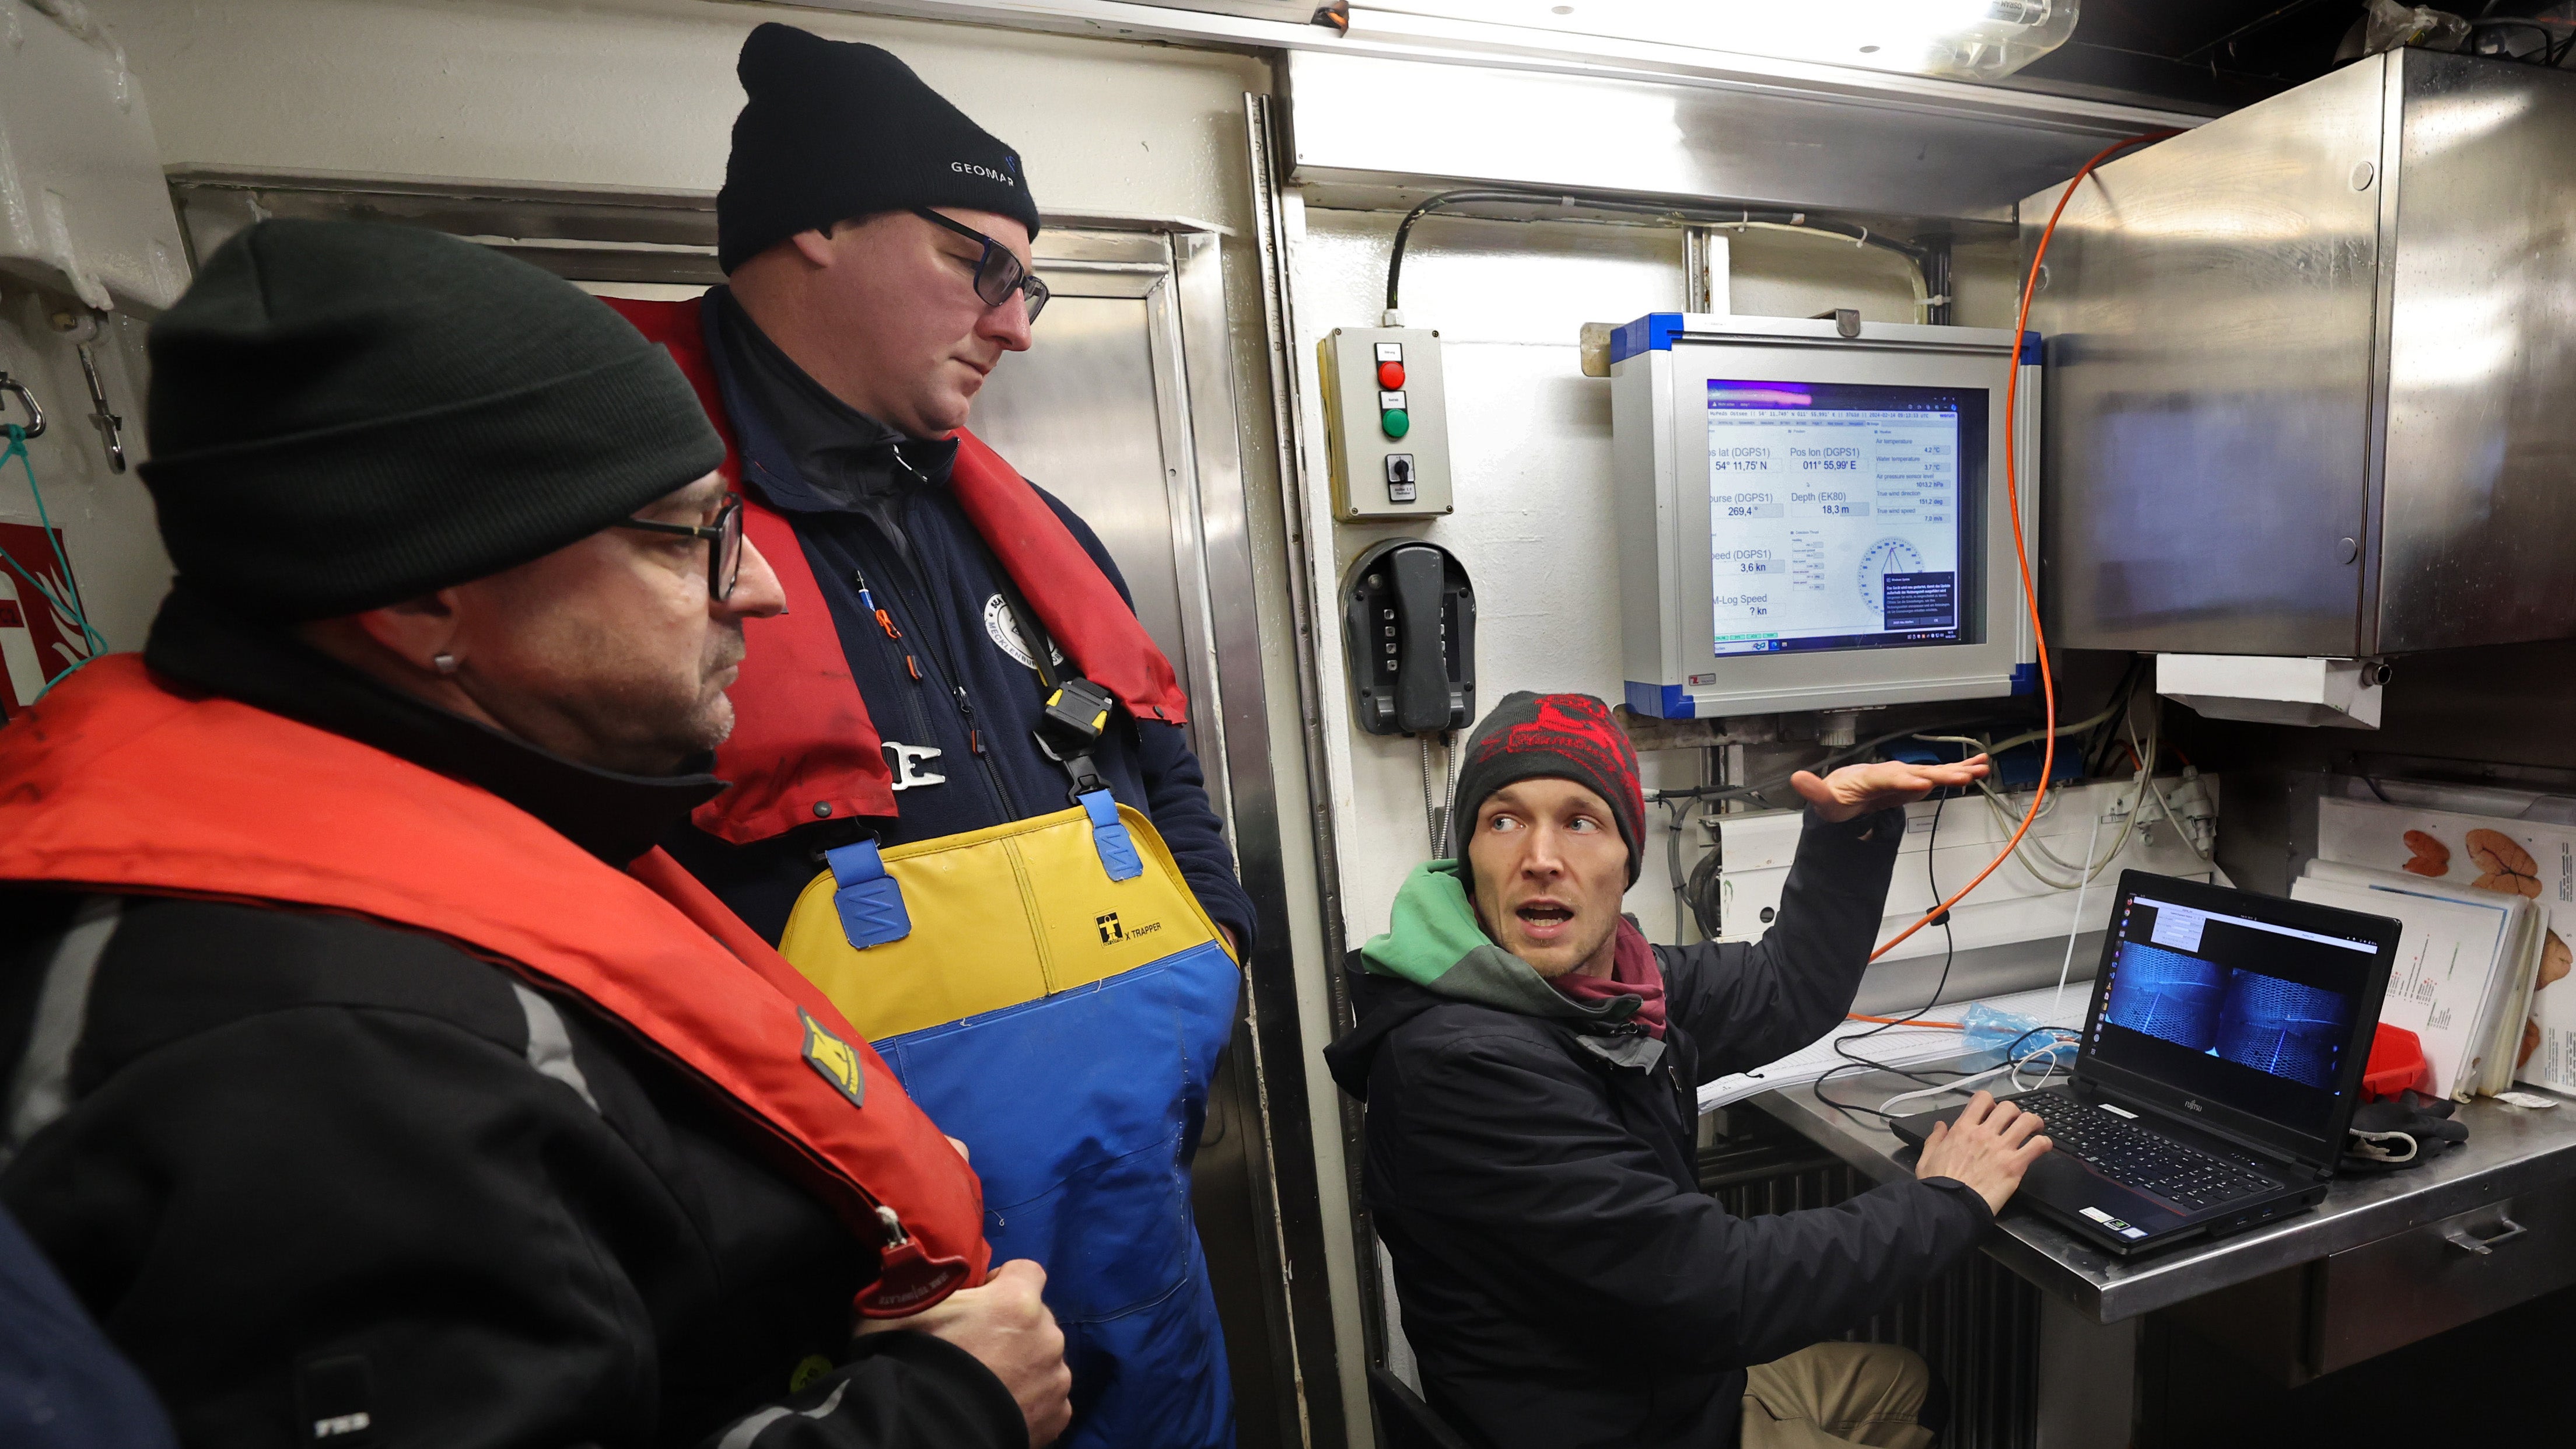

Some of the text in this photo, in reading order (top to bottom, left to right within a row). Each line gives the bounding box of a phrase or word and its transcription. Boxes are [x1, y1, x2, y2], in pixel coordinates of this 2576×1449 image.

[2001, 1, 2022, 9] OSRAM
[951, 160, 1014, 187] GEOMAR
[1718, 448, 1729, 457] lat
[1732, 447, 1770, 459] (DGPS1)
[1790, 447, 1860, 458] Pos lon (DGPS1)
[1716, 461, 1730, 470] 54°
[1760, 461, 1767, 470] N
[1850, 461, 1856, 470] E
[1735, 493, 1773, 504] (DGPS1)
[1791, 492, 1846, 503] Depth (EK80)
[1728, 506, 1752, 516] 269,4
[1822, 505, 1839, 514] 18,3
[1733, 550, 1772, 562] (DGPS1)
[1740, 562, 1766, 573] 3,6 kn
[1741, 594, 1768, 605] Speed
[1757, 607, 1767, 615] kn
[988, 621, 1037, 667] MECKLENBUR
[1125, 922, 1162, 940] X TRAPPER
[2185, 1099, 2203, 1112] FUJITSU
